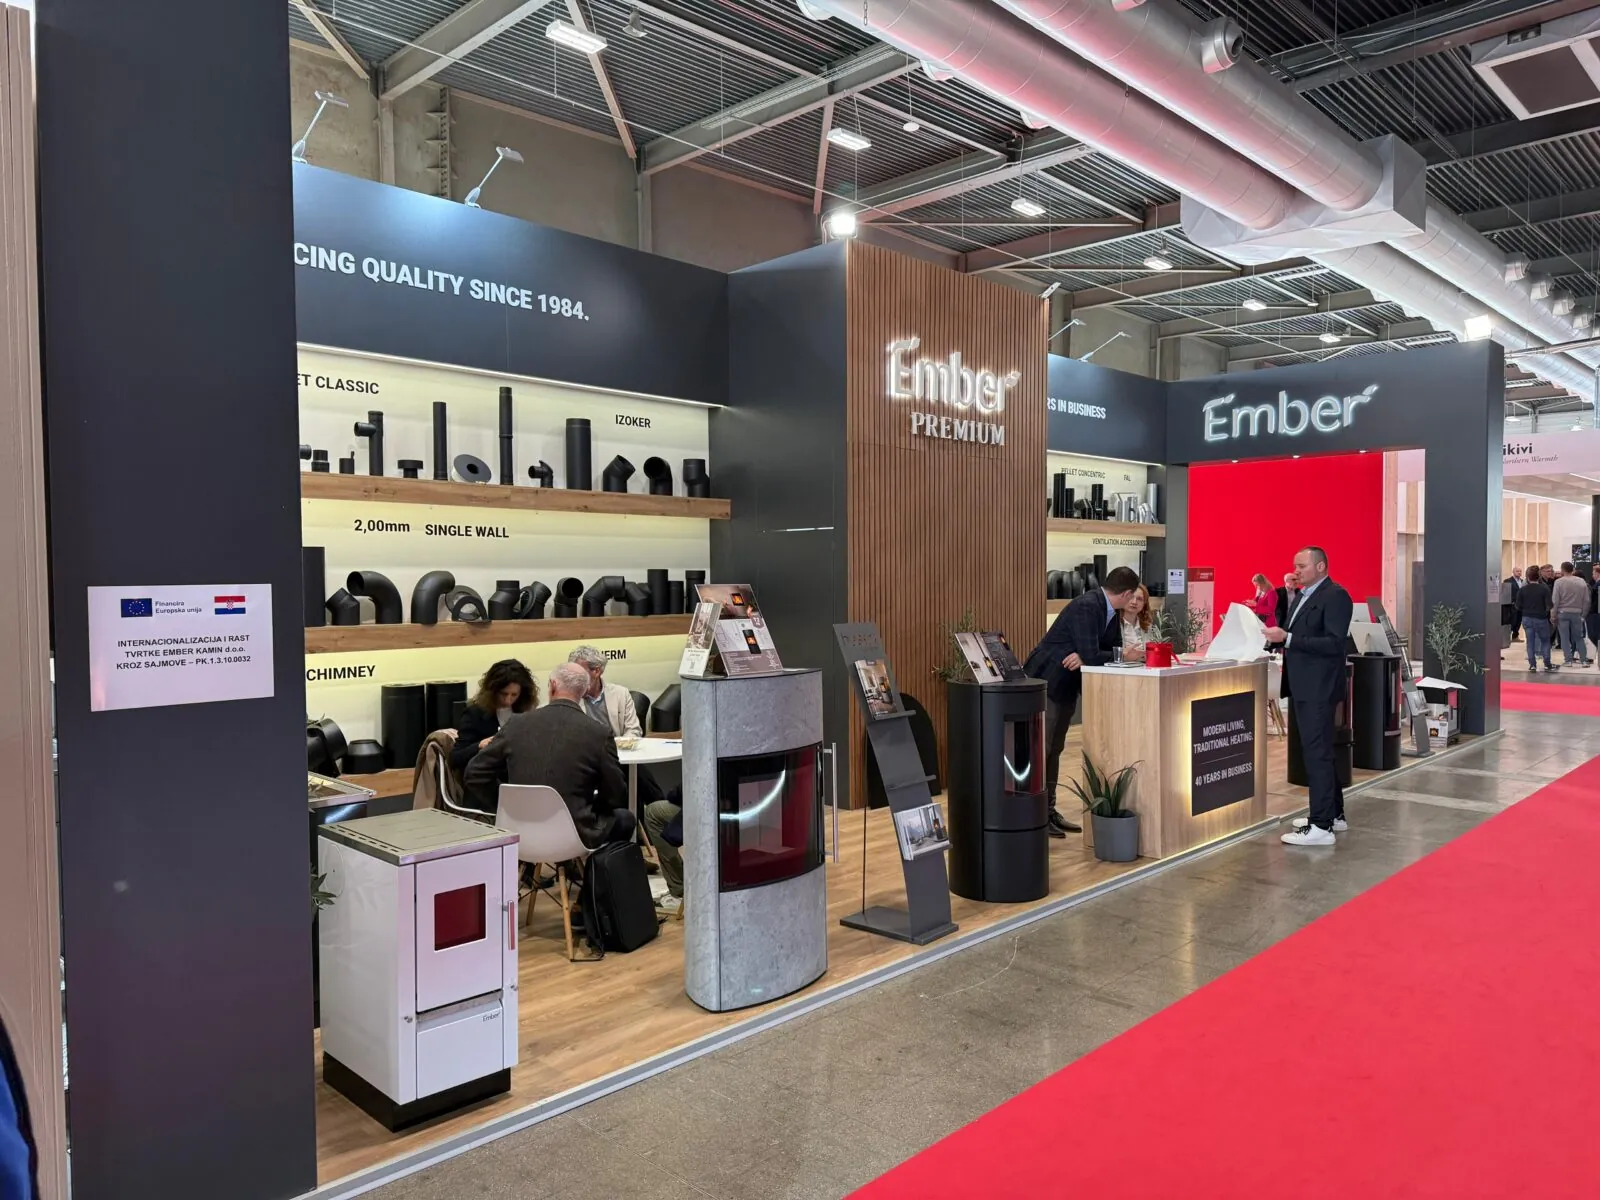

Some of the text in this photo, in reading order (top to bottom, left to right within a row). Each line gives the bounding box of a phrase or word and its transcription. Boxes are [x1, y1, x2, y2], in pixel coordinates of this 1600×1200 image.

[362, 257, 464, 296] QUALITY
[469, 279, 533, 310] SINCE
[537, 294, 591, 322] 1984.
[888, 338, 1021, 413] Ember
[315, 375, 380, 395] CLASSIC
[1057, 399, 1067, 413] IN
[1068, 401, 1106, 419] BUSINESS
[1202, 384, 1379, 443] Ember
[615, 414, 651, 428] IZOKER
[911, 411, 1005, 447] PREMIUM
[1061, 467, 1106, 479] PELLET CONCENTRIC
[353, 519, 510, 538] 2,00mm SINGLE WALL
[1092, 538, 1147, 547] VENTILATION ACCESSORIES
[155, 606, 202, 615] Europska unija
[117, 637, 222, 647] INTERNACIONALIZACIJA
[228, 634, 251, 643] RAST
[125, 649, 161, 659] TVRTKE
[162, 647, 194, 657] EMBER
[195, 645, 223, 655] KAMIN
[116, 661, 142, 671] KROZ
[144, 657, 187, 669] SAJMOVE
[195, 655, 252, 666] PK.1.3.10.0032
[306, 664, 376, 682] CHIMNEY
[1203, 720, 1245, 737] MODERN LIVING,
[1194, 732, 1253, 754] TRADITIONAL HEATING.
[1195, 762, 1252, 787] 40 YEARS IN BUSINESS
